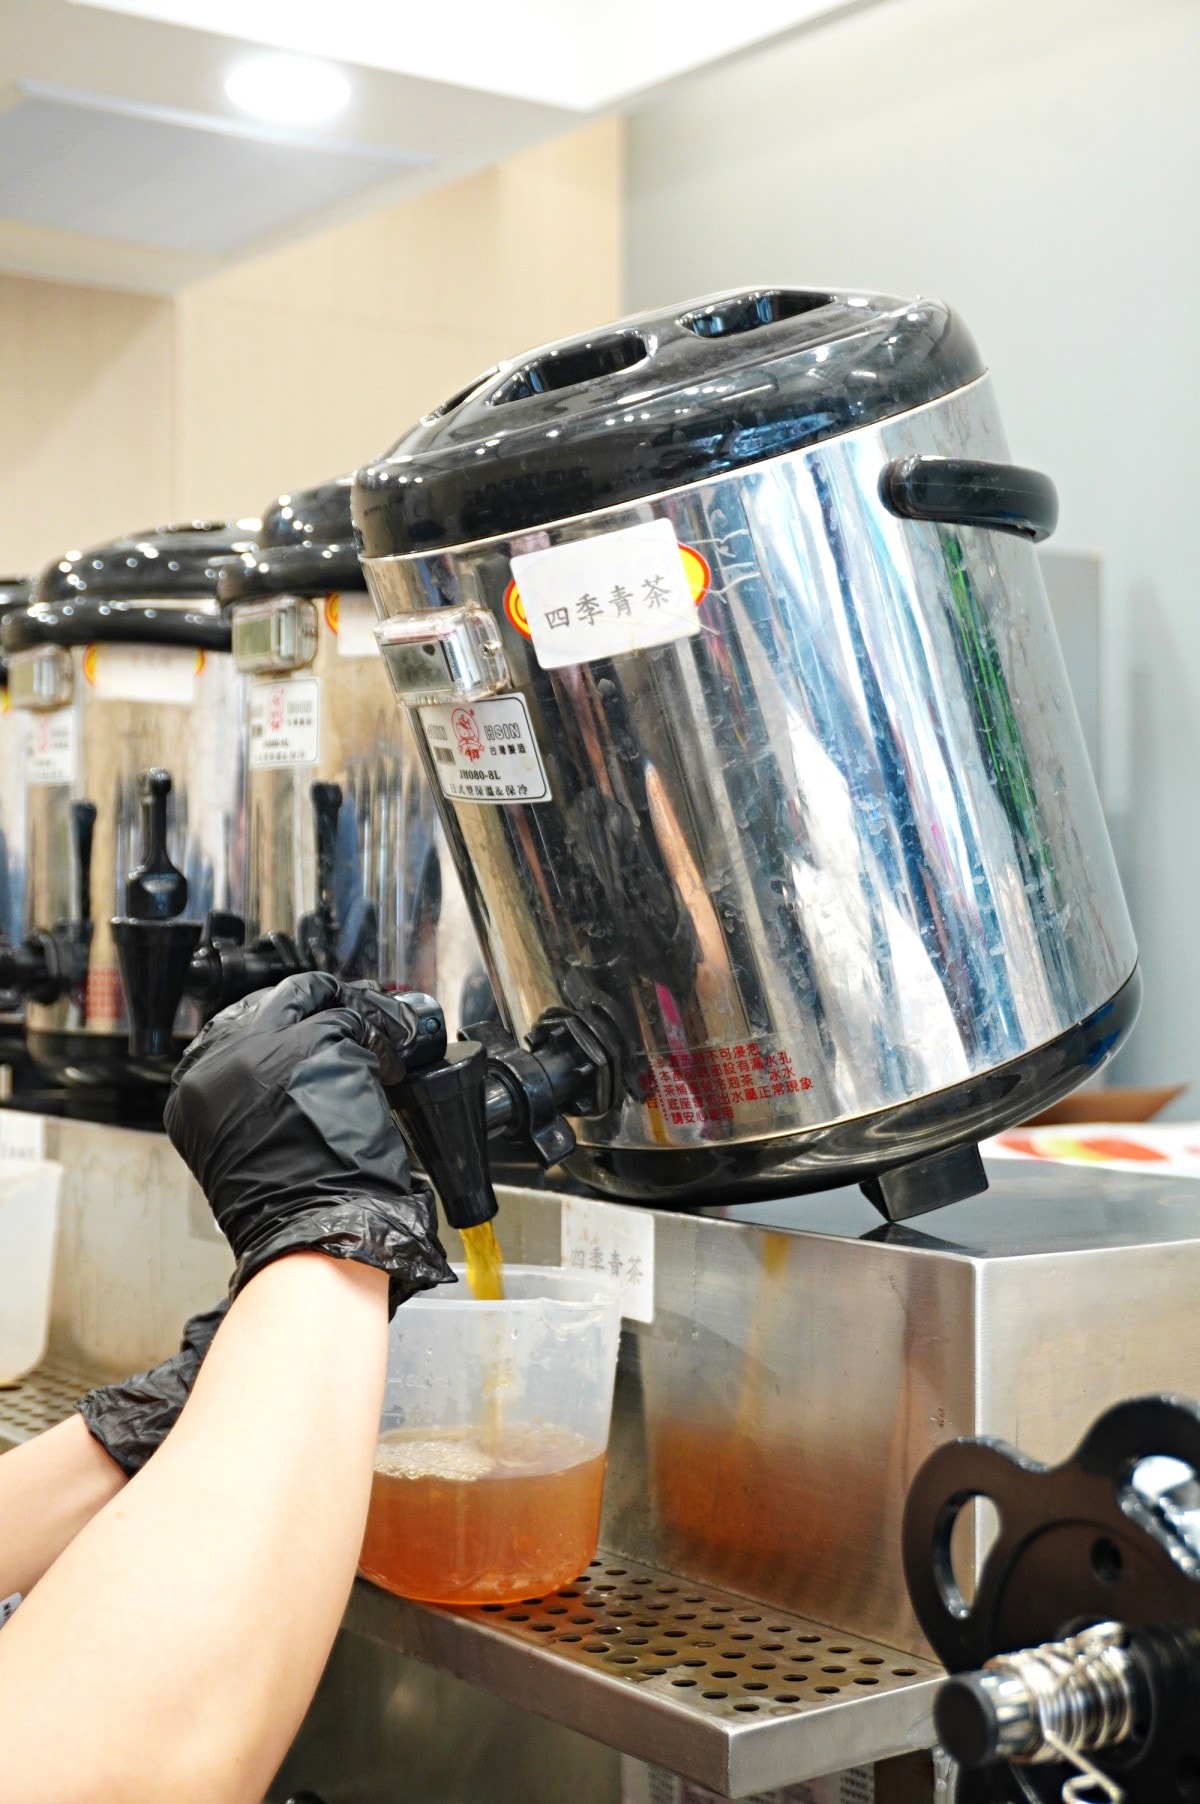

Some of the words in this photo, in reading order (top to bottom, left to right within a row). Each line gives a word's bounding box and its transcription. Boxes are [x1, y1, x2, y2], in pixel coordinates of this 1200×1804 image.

[544, 574, 672, 629] 四季青茶
[484, 722, 521, 741] HSIN
[571, 1246, 644, 1285] 四季青茶
